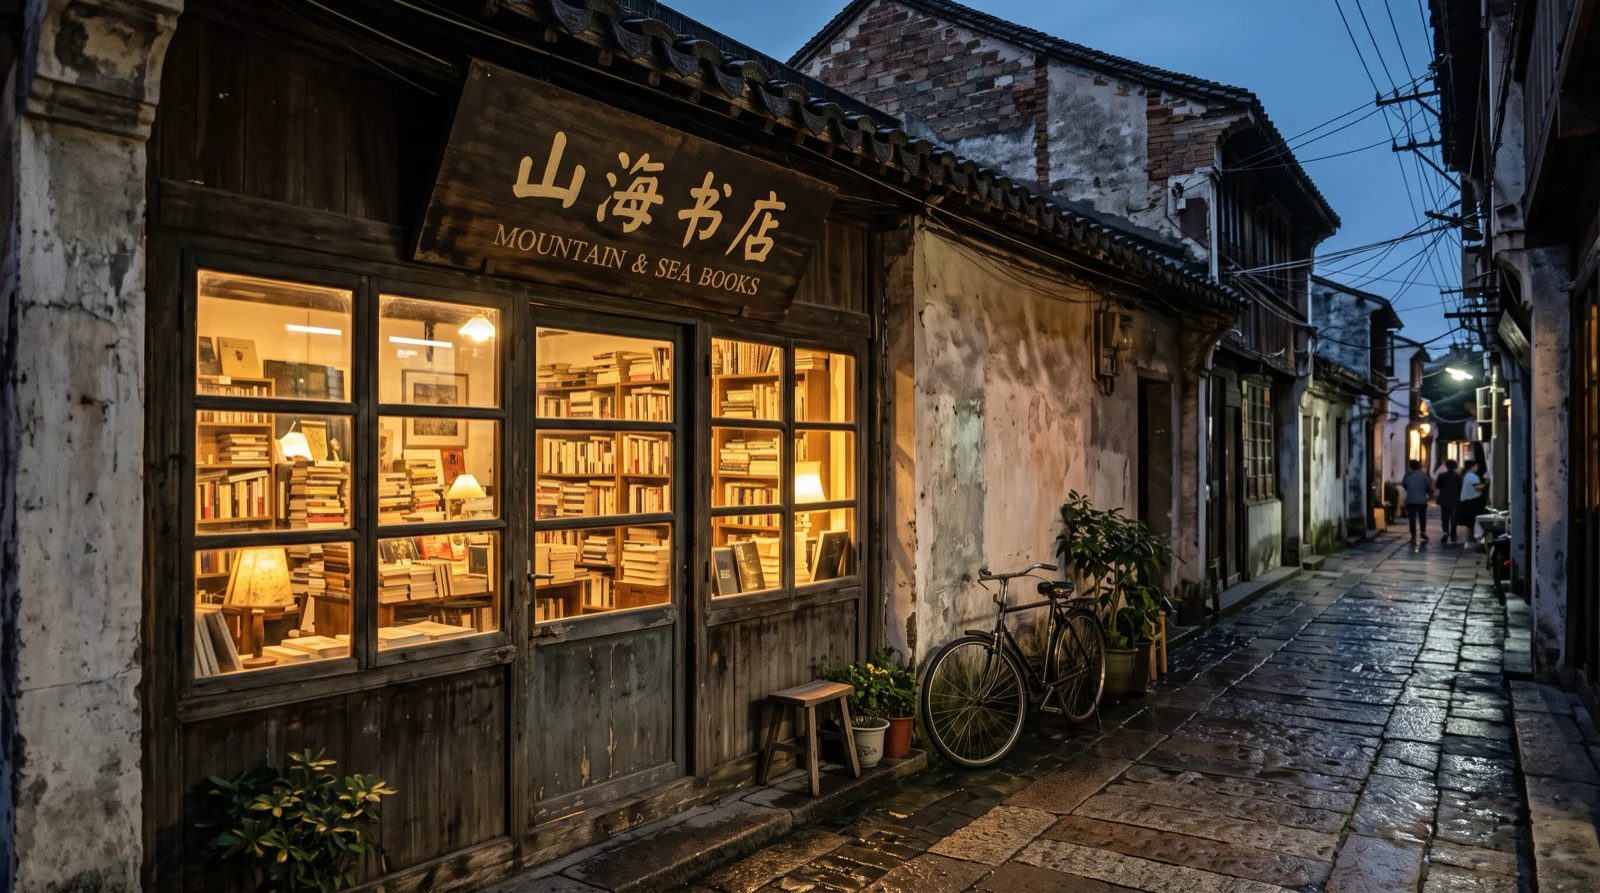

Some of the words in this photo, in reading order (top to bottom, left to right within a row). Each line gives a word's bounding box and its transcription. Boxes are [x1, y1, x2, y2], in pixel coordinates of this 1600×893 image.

[512, 131, 786, 262] 山海书店
[492, 224, 627, 270] MOUNTAIN
[631, 253, 648, 274] &
[655, 258, 691, 283] SEA
[698, 267, 760, 296] BOOKS
